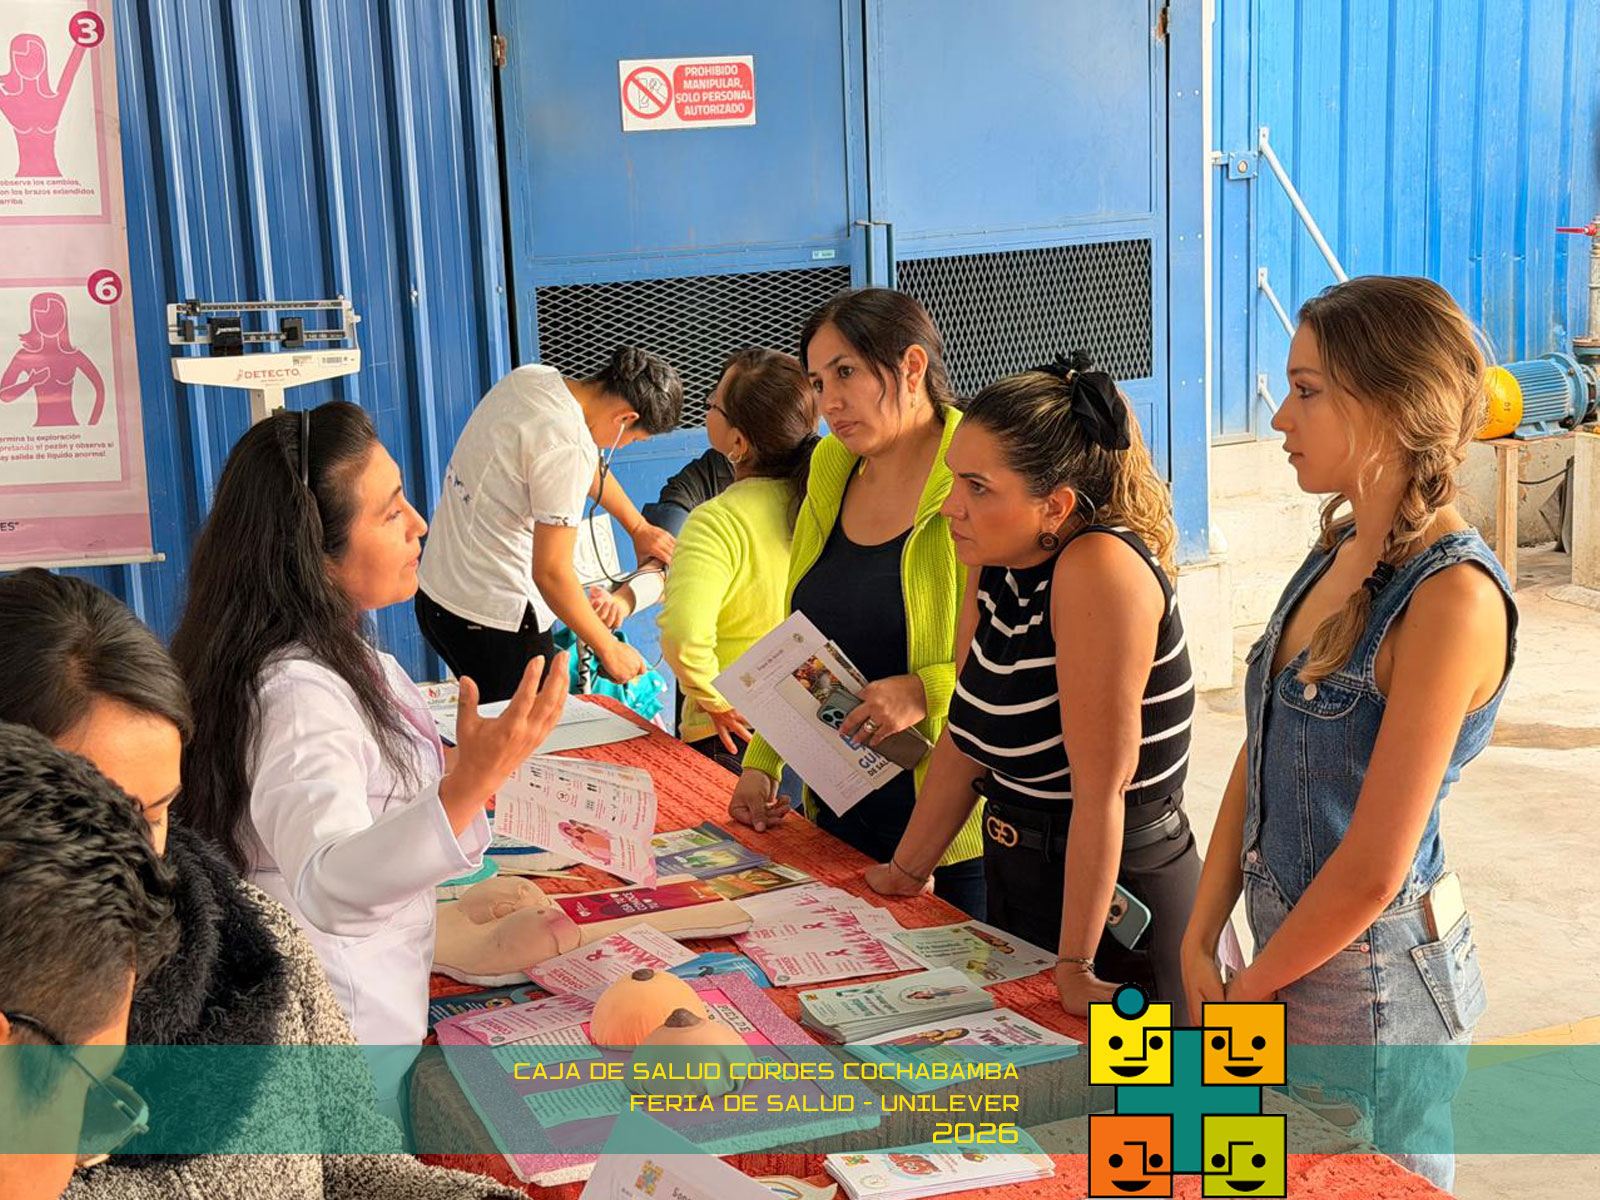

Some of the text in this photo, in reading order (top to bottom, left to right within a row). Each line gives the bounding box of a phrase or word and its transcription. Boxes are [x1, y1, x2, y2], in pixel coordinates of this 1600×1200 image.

[77, 18, 98, 44] 3
[685, 65, 738, 77] PROHIBIDO
[683, 78, 743, 90] MANIPULAR,
[675, 90, 752, 104] SOLO PERSONAL
[684, 103, 745, 116] AUTORIZADO
[95, 276, 118, 302] 6
[244, 368, 300, 379] DETECTO
